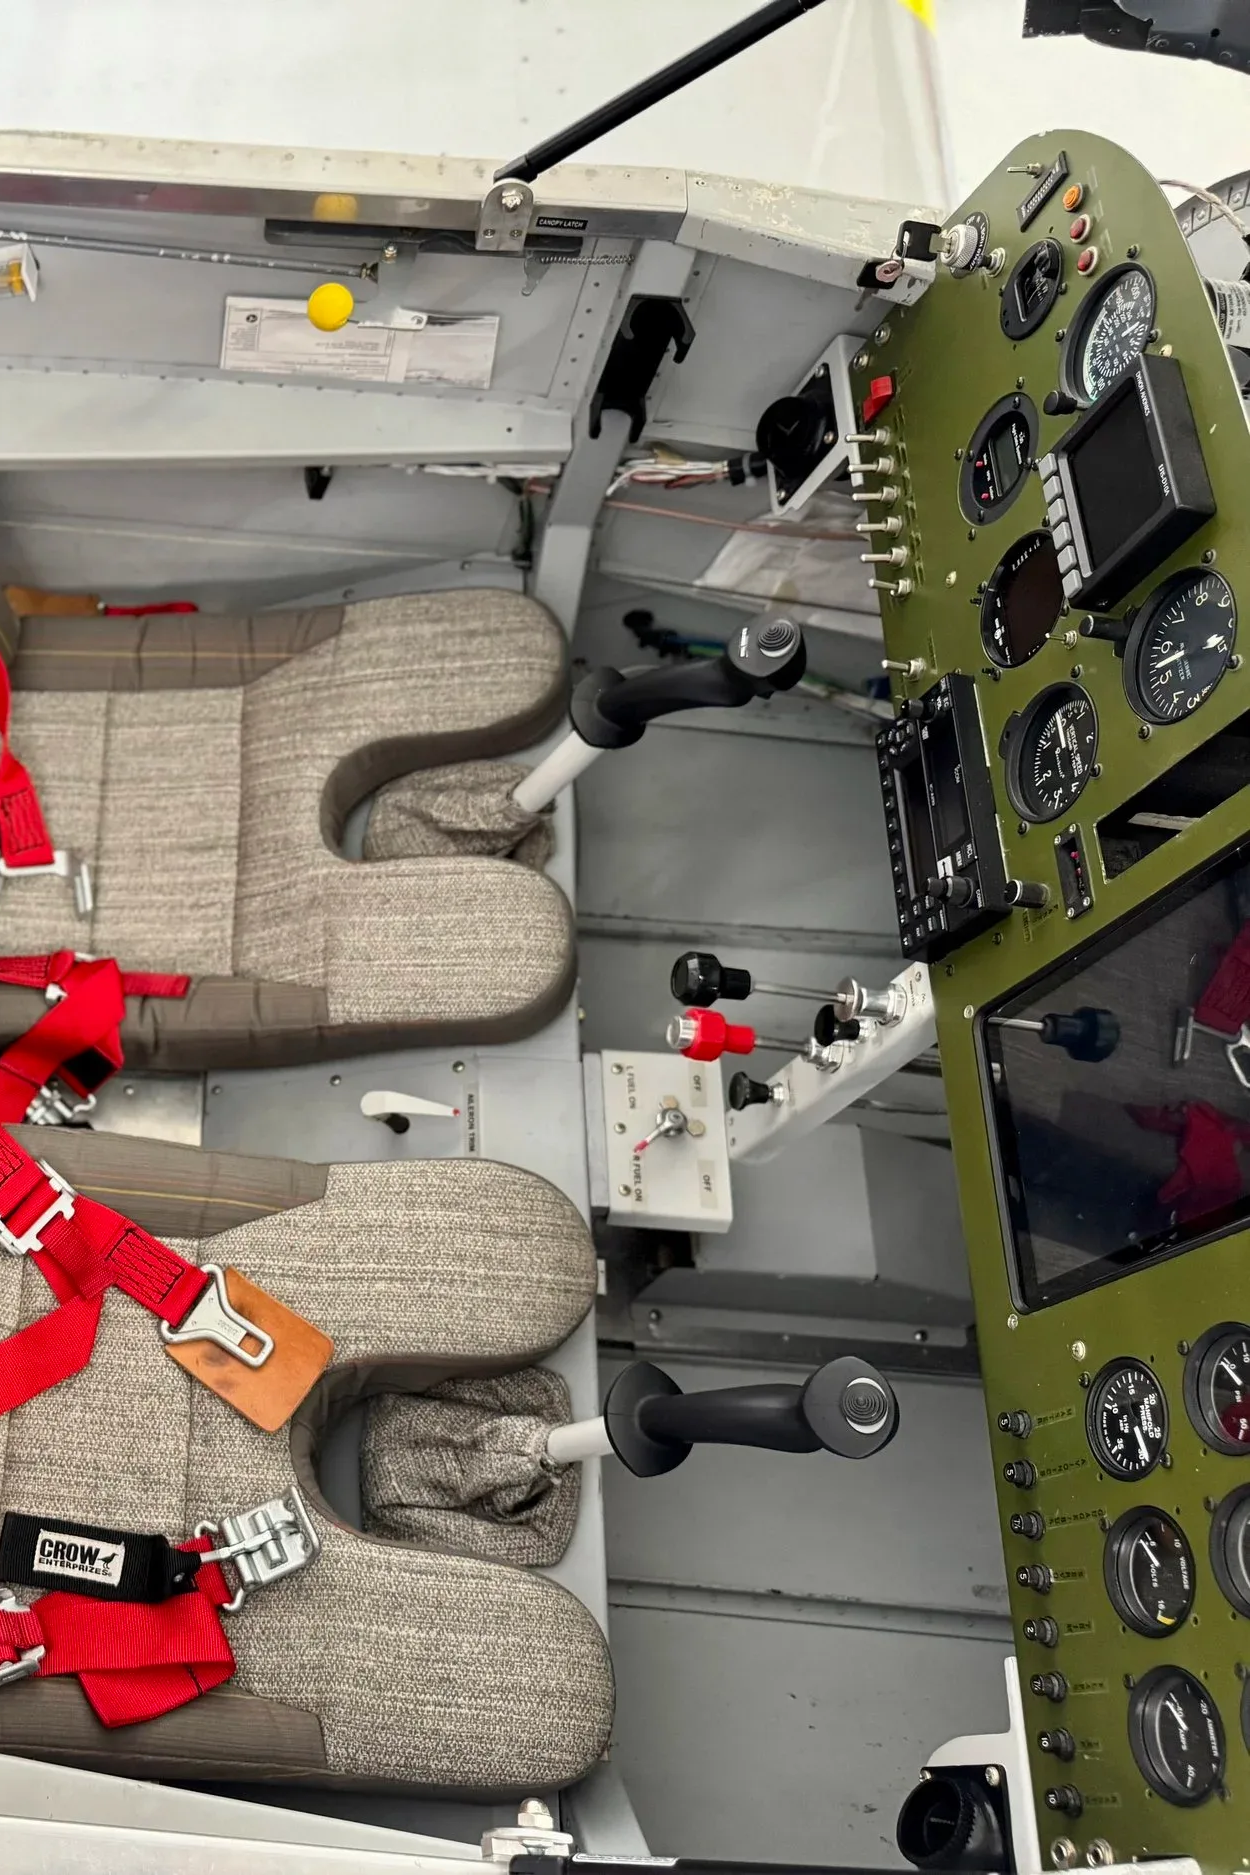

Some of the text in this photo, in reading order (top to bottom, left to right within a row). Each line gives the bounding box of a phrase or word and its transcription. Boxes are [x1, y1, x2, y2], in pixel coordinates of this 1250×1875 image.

[539, 219, 562, 227] CANOPY
[1140, 391, 1150, 417] AVIONICS
[1194, 592, 1209, 607] 8
[1171, 612, 1185, 624] 7
[1159, 640, 1174, 654] 6
[1158, 670, 1173, 685] 5
[1171, 691, 1186, 703] 4
[1186, 694, 1201, 709] 3
[1069, 723, 1083, 775] VERTICAL SPEED
[1042, 770, 1052, 779] 2
[1053, 787, 1064, 799] 3
[1070, 782, 1080, 793] 4
[955, 851, 963, 867] MEM
[627, 1073, 635, 1094] FUEL
[693, 1075, 702, 1092] OFF
[628, 1096, 636, 1109] ON
[633, 1163, 642, 1185] FUEL
[702, 1174, 712, 1192] OFF
[635, 1190, 642, 1202] ON
[1241, 1352, 1250, 1364] 10
[1127, 1384, 1136, 1396] 15
[1233, 1389, 1242, 1403] PSI
[1147, 1393, 1158, 1406] 20
[1037, 1408, 1073, 1425] MASTER
[1110, 1403, 1119, 1415] 10
[1000, 1418, 1006, 1426] 5
[1139, 1405, 1148, 1433] PRESS.
[1143, 1397, 1155, 1438] MANIFOLD
[1153, 1425, 1163, 1439] 25
[1115, 1437, 1125, 1450] 35
[1040, 1458, 1087, 1477] AVIONICS
[1173, 1537, 1182, 1549] 10
[40, 1538, 100, 1565] CROW
[1149, 1563, 1159, 1588] VOLTS
[1179, 1556, 1190, 1590] VOLTAGE
[1198, 1699, 1209, 1716] -20
[1041, 1737, 1049, 1748] 10
[1177, 1728, 1189, 1751] AMPS
[1206, 1717, 1219, 1757] AMMETER
[1186, 1763, 1197, 1778] 40
[1048, 1793, 1056, 1805] 10
